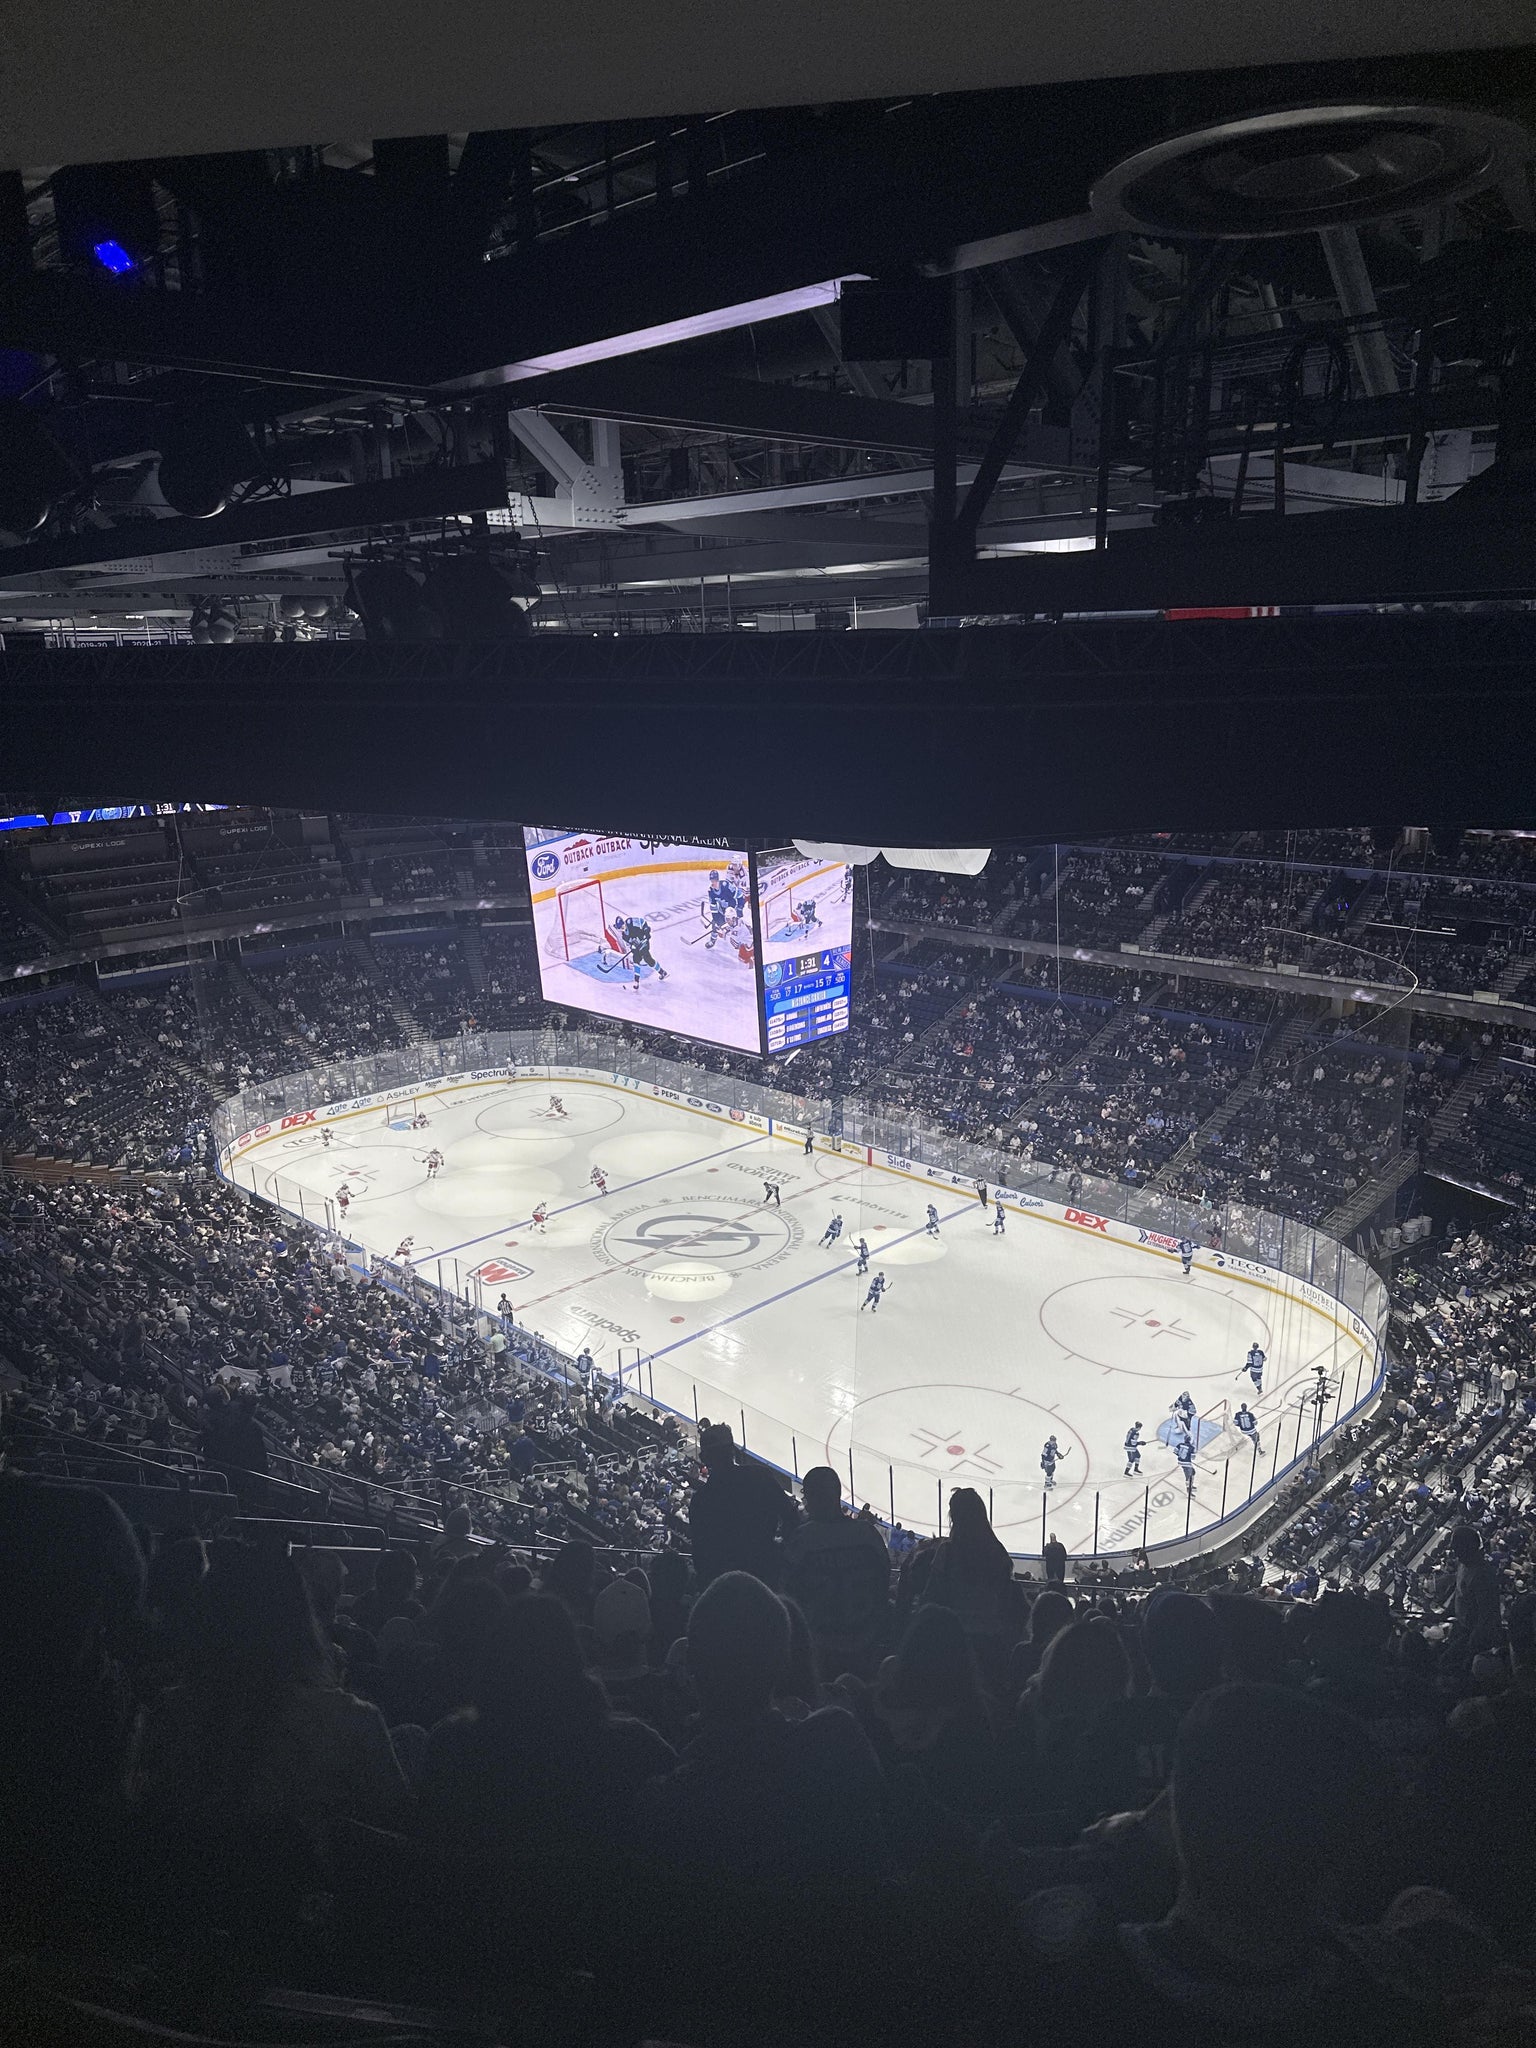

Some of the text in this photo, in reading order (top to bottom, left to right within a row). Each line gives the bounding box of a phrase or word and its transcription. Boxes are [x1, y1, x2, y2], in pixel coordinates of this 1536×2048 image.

[156, 803, 173, 812] 1:31
[596, 838, 632, 856] OUTBACK
[563, 847, 595, 865] OUTBACK
[800, 957, 816, 970] 1:31
[823, 954, 830, 966] 4
[788, 964, 793, 976] 1
[794, 984, 803, 994] 17
[815, 979, 824, 988] 15
[470, 1068, 511, 1081] Spectru
[386, 1087, 421, 1100] ASHLEY
[661, 1090, 680, 1101] PEPSI
[281, 1110, 318, 1130] DEX
[887, 1155, 912, 1170] Slide
[726, 1162, 790, 1185] RAYMOND
[756, 1165, 801, 1180] JAMES
[995, 1189, 1018, 1200] Culver's
[1020, 1197, 1044, 1207] Culver's
[611, 1204, 650, 1223] ARENA
[1064, 1208, 1110, 1232] DEX
[682, 1196, 805, 1271] BENCHMARK INTERNATIONAL ARENA
[1228, 1264, 1246, 1275] TAMPA
[1229, 1257, 1267, 1274] TECO
[620, 1267, 715, 1283] BENCHMARK
[1300, 1284, 1335, 1310] AUDIBEL
[570, 1306, 641, 1343] Spectrum
